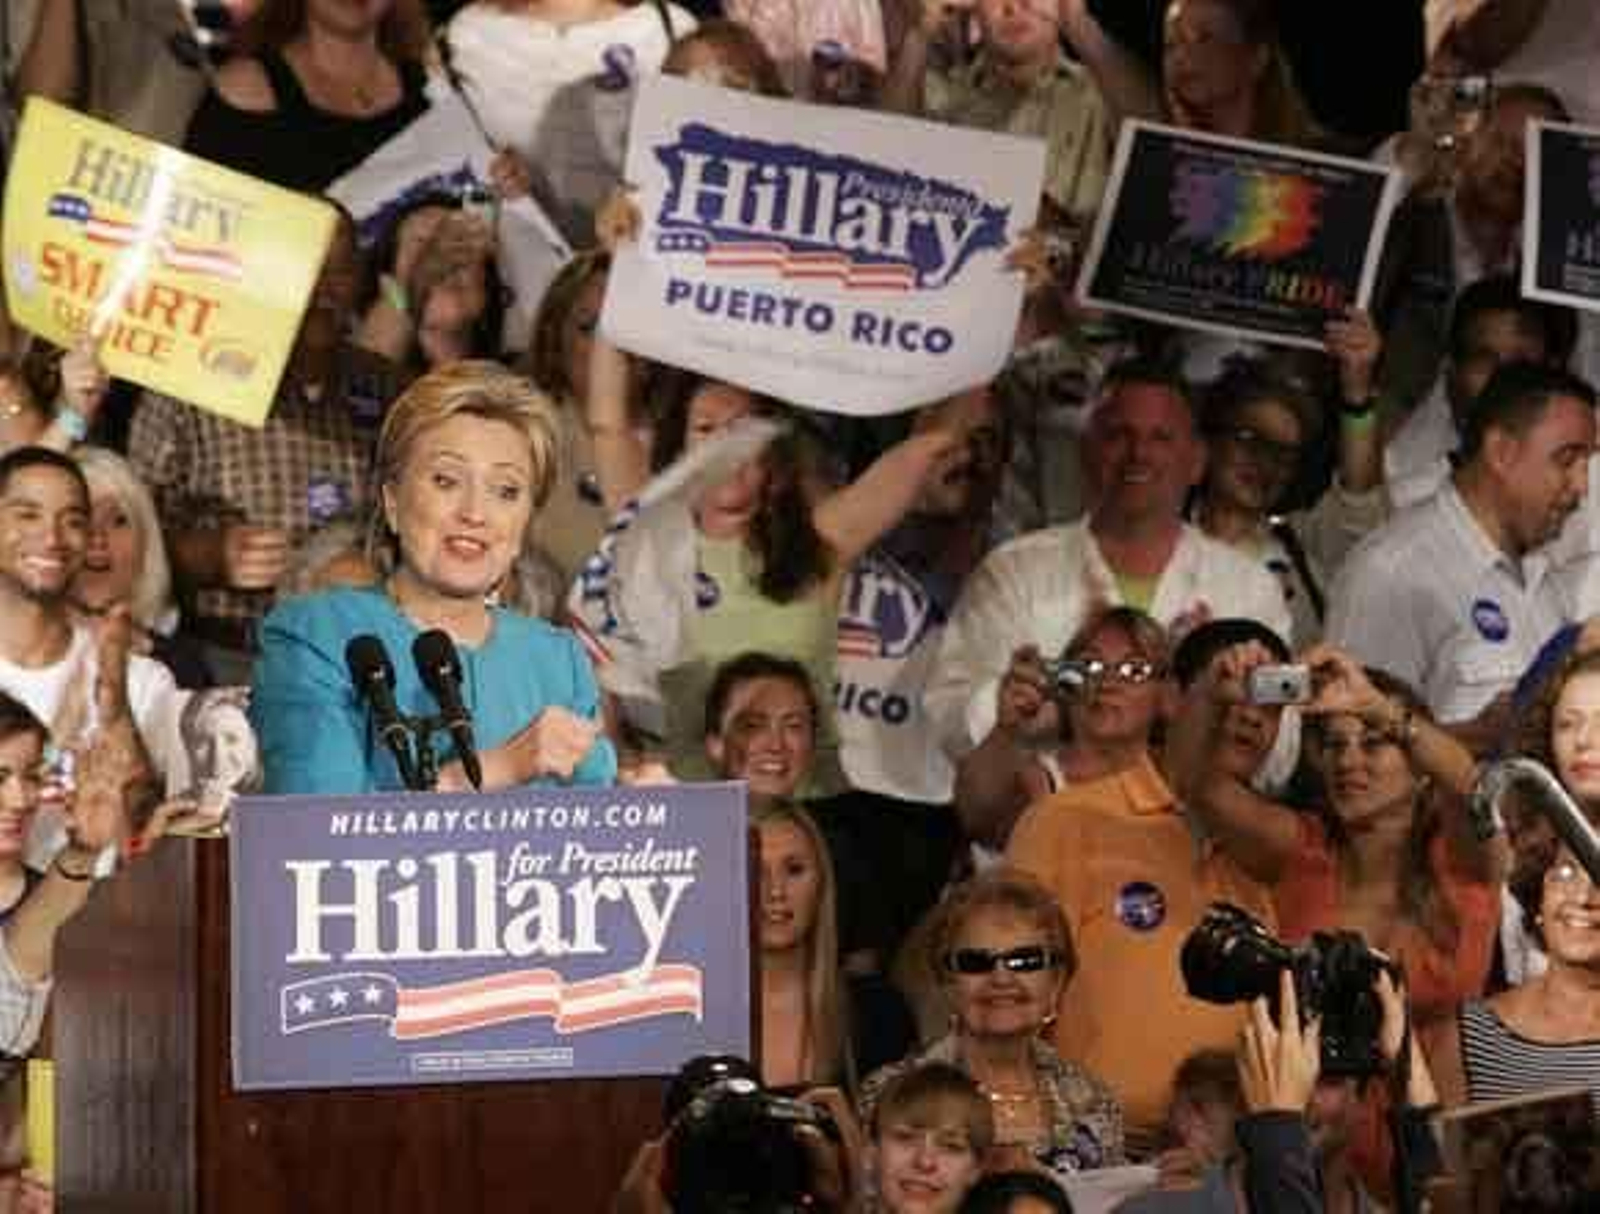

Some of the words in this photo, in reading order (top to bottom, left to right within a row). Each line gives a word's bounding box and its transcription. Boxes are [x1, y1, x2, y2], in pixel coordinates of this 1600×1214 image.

[667, 151, 988, 289] Hillary
[665, 279, 834, 333] PUERTO
[851, 312, 955, 355] RICO
[834, 681, 909, 725] ICO
[330, 803, 668, 835] HILLARYCLINTON.COM
[501, 841, 552, 887] for
[558, 838, 699, 875] President
[285, 850, 696, 990] Hillary
